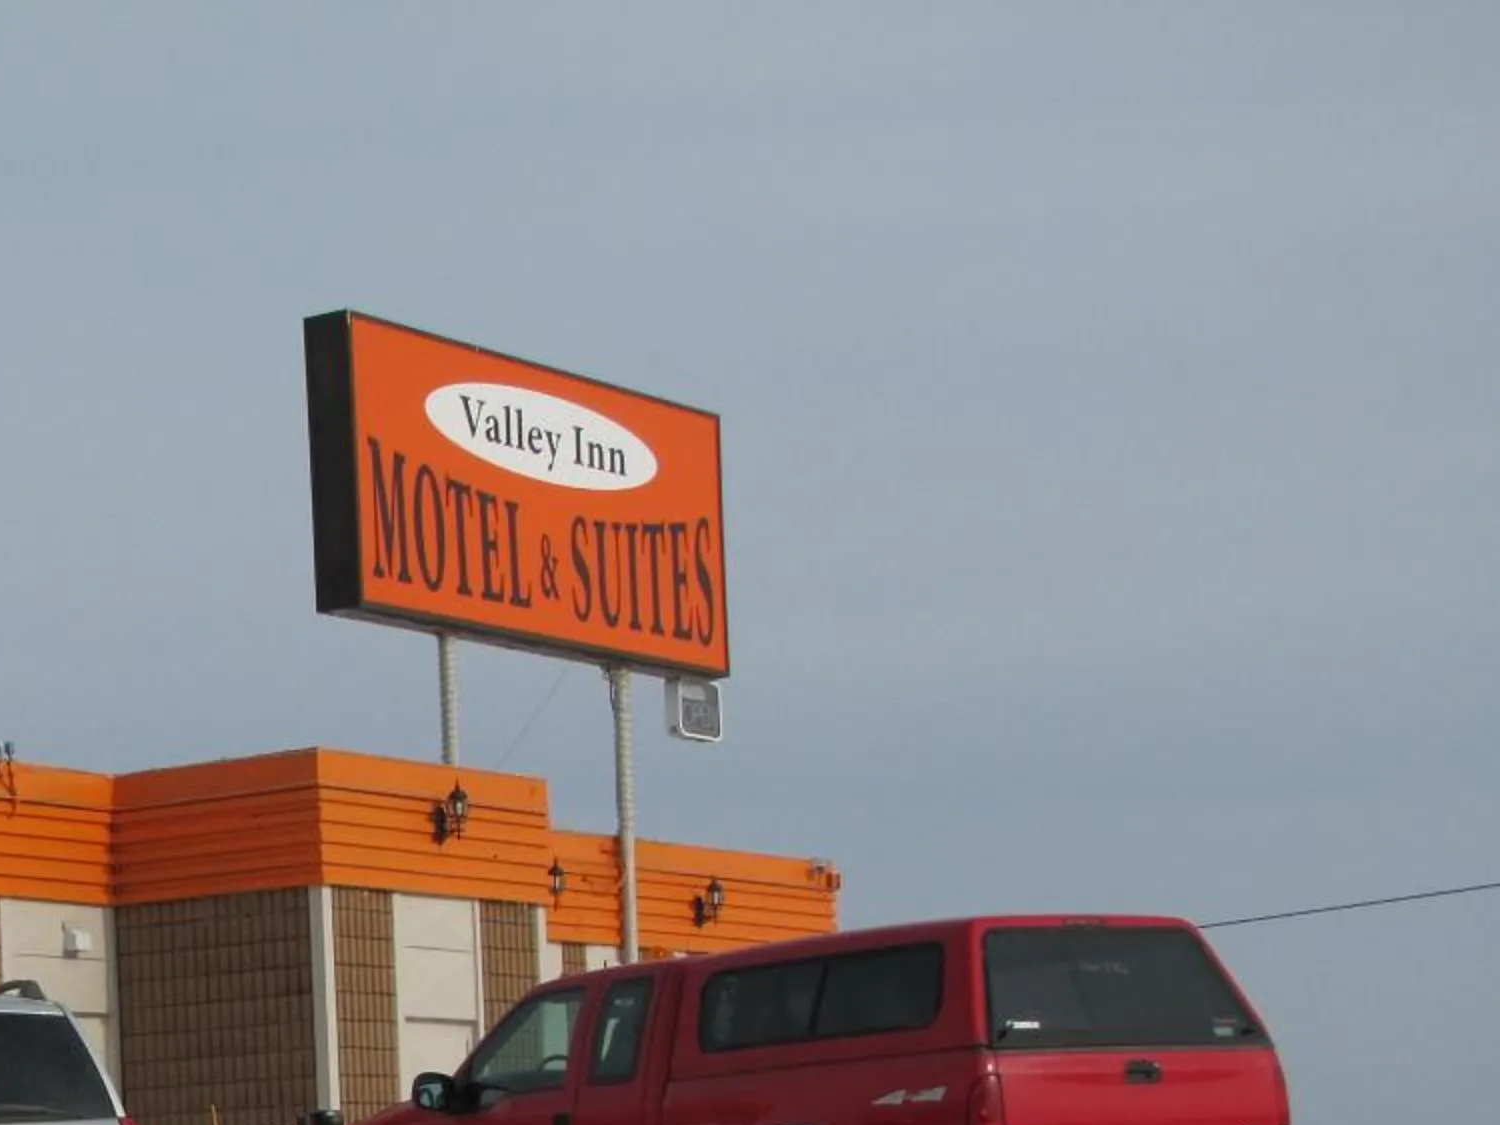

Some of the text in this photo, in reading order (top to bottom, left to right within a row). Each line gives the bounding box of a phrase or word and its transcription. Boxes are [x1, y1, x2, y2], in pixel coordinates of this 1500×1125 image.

[459, 394, 627, 476] Valley Inn
[367, 435, 715, 647] MOTEL & SUITES
